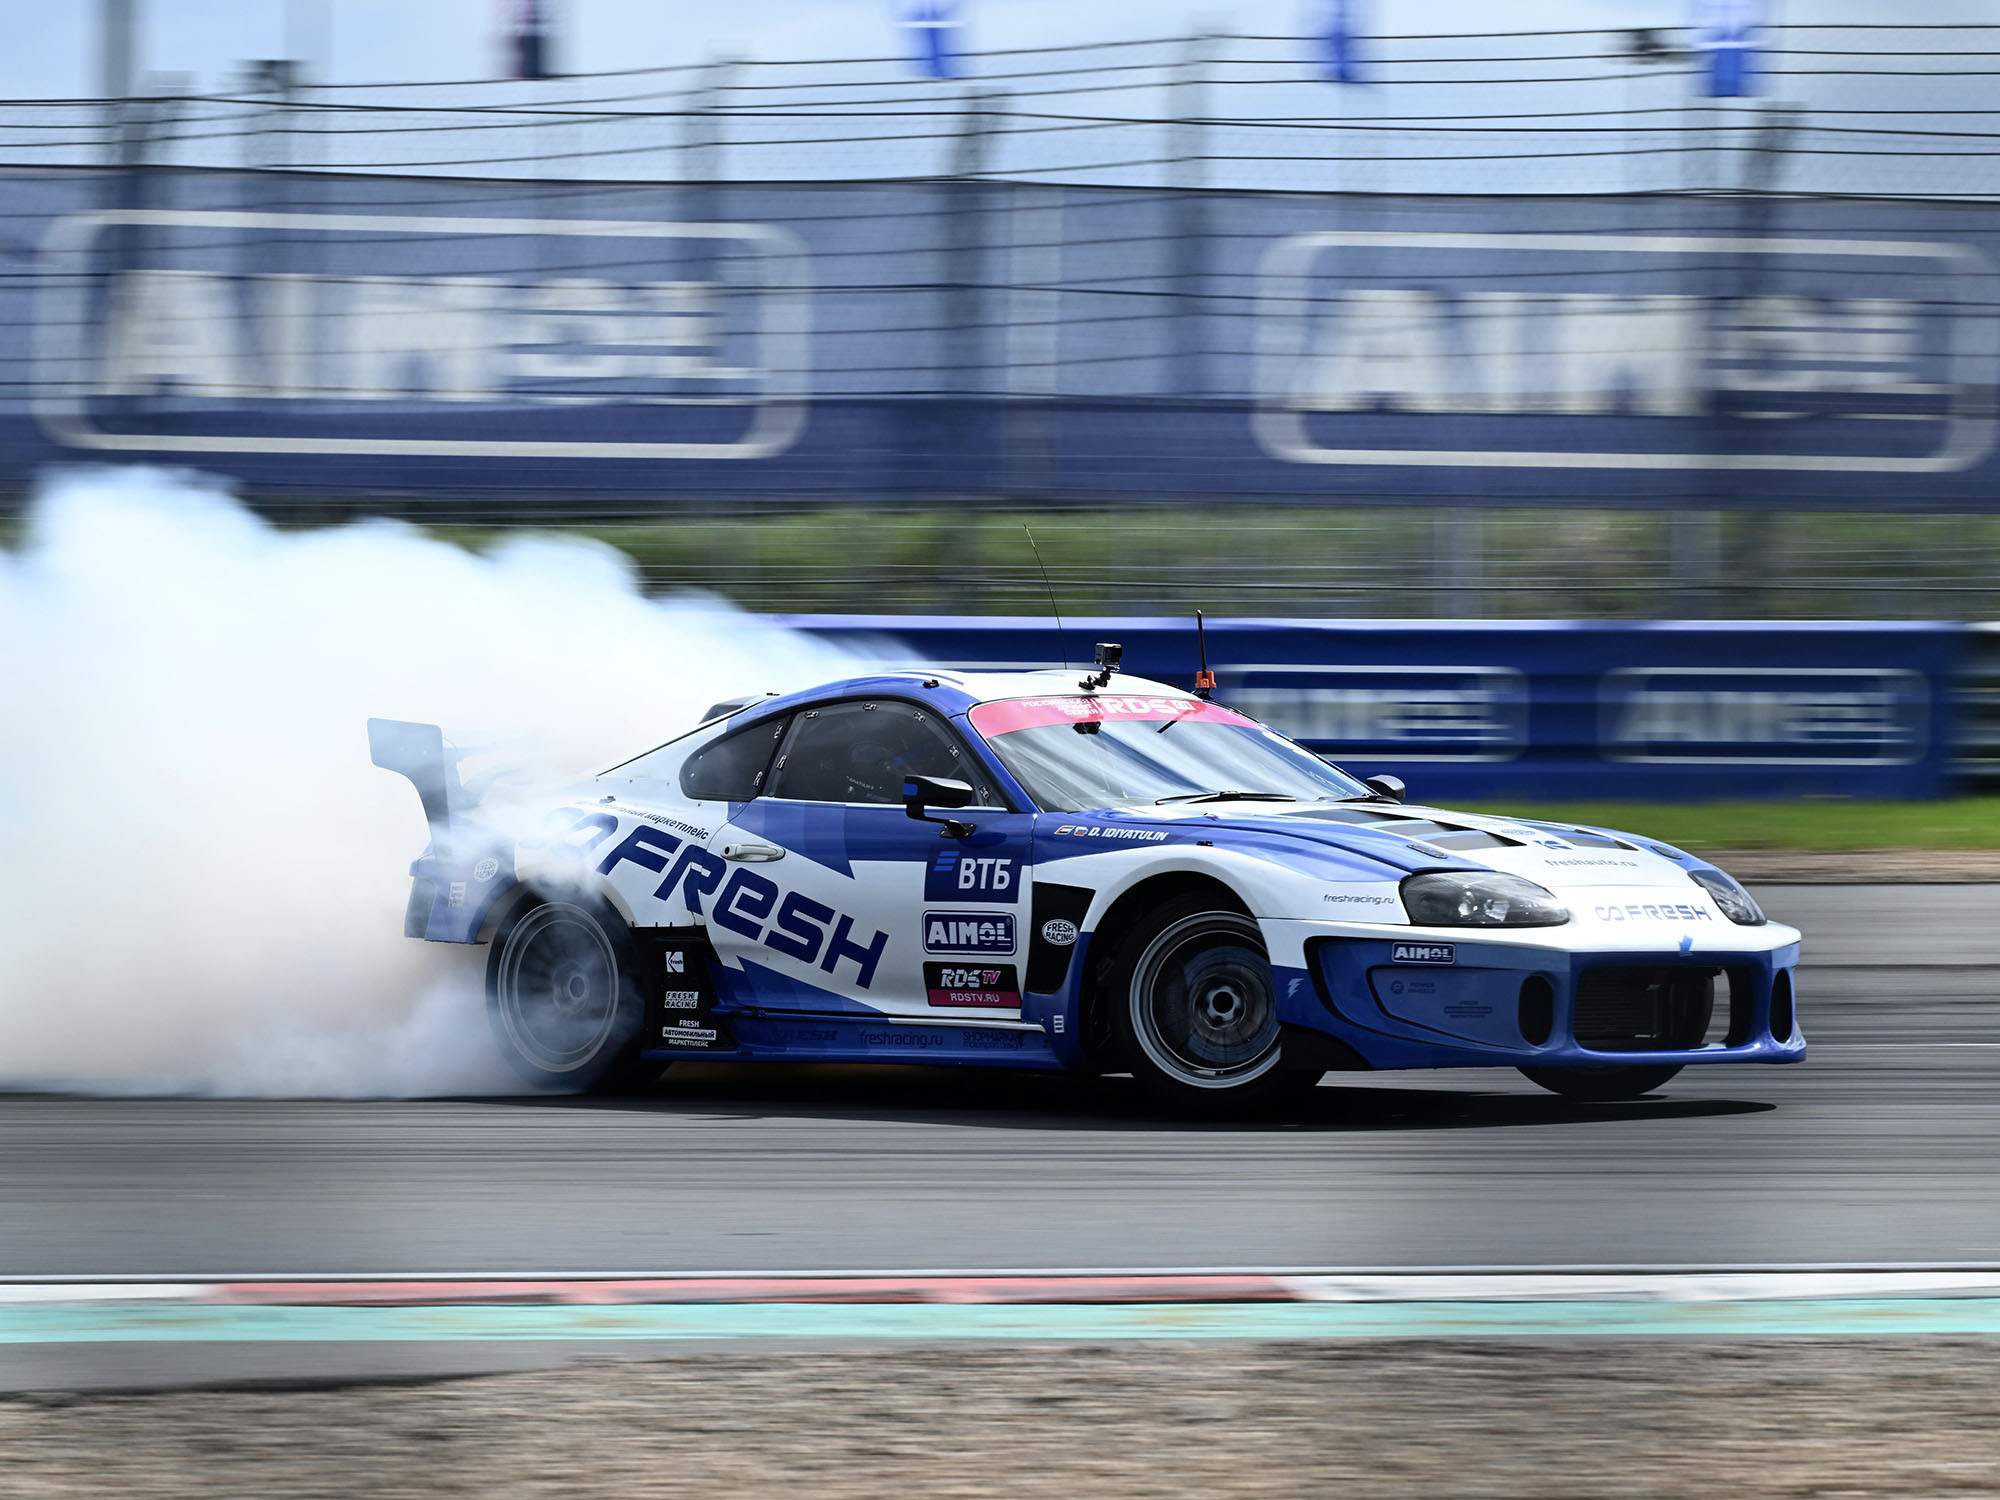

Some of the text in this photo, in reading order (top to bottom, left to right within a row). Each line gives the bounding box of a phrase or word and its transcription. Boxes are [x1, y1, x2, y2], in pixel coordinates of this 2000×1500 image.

[1099, 698, 1179, 714] RDS
[644, 812, 709, 840] маркетплейс
[1088, 827, 1169, 840] D. IDIYATULIN
[958, 858, 1012, 890] ВТБ
[1324, 894, 1395, 905] freshracing.ru
[927, 921, 1012, 946] AIMOL
[1046, 922, 1074, 933] FRESH
[1045, 931, 1075, 943] RACING
[1394, 947, 1452, 961] AIMOL
[666, 992, 695, 1000] FRESH
[950, 992, 1000, 1003] RDSTV.RU
[665, 1000, 697, 1008] RACING
[679, 1019, 700, 1028] FRESH
[860, 1031, 943, 1049] freshracing.ru
